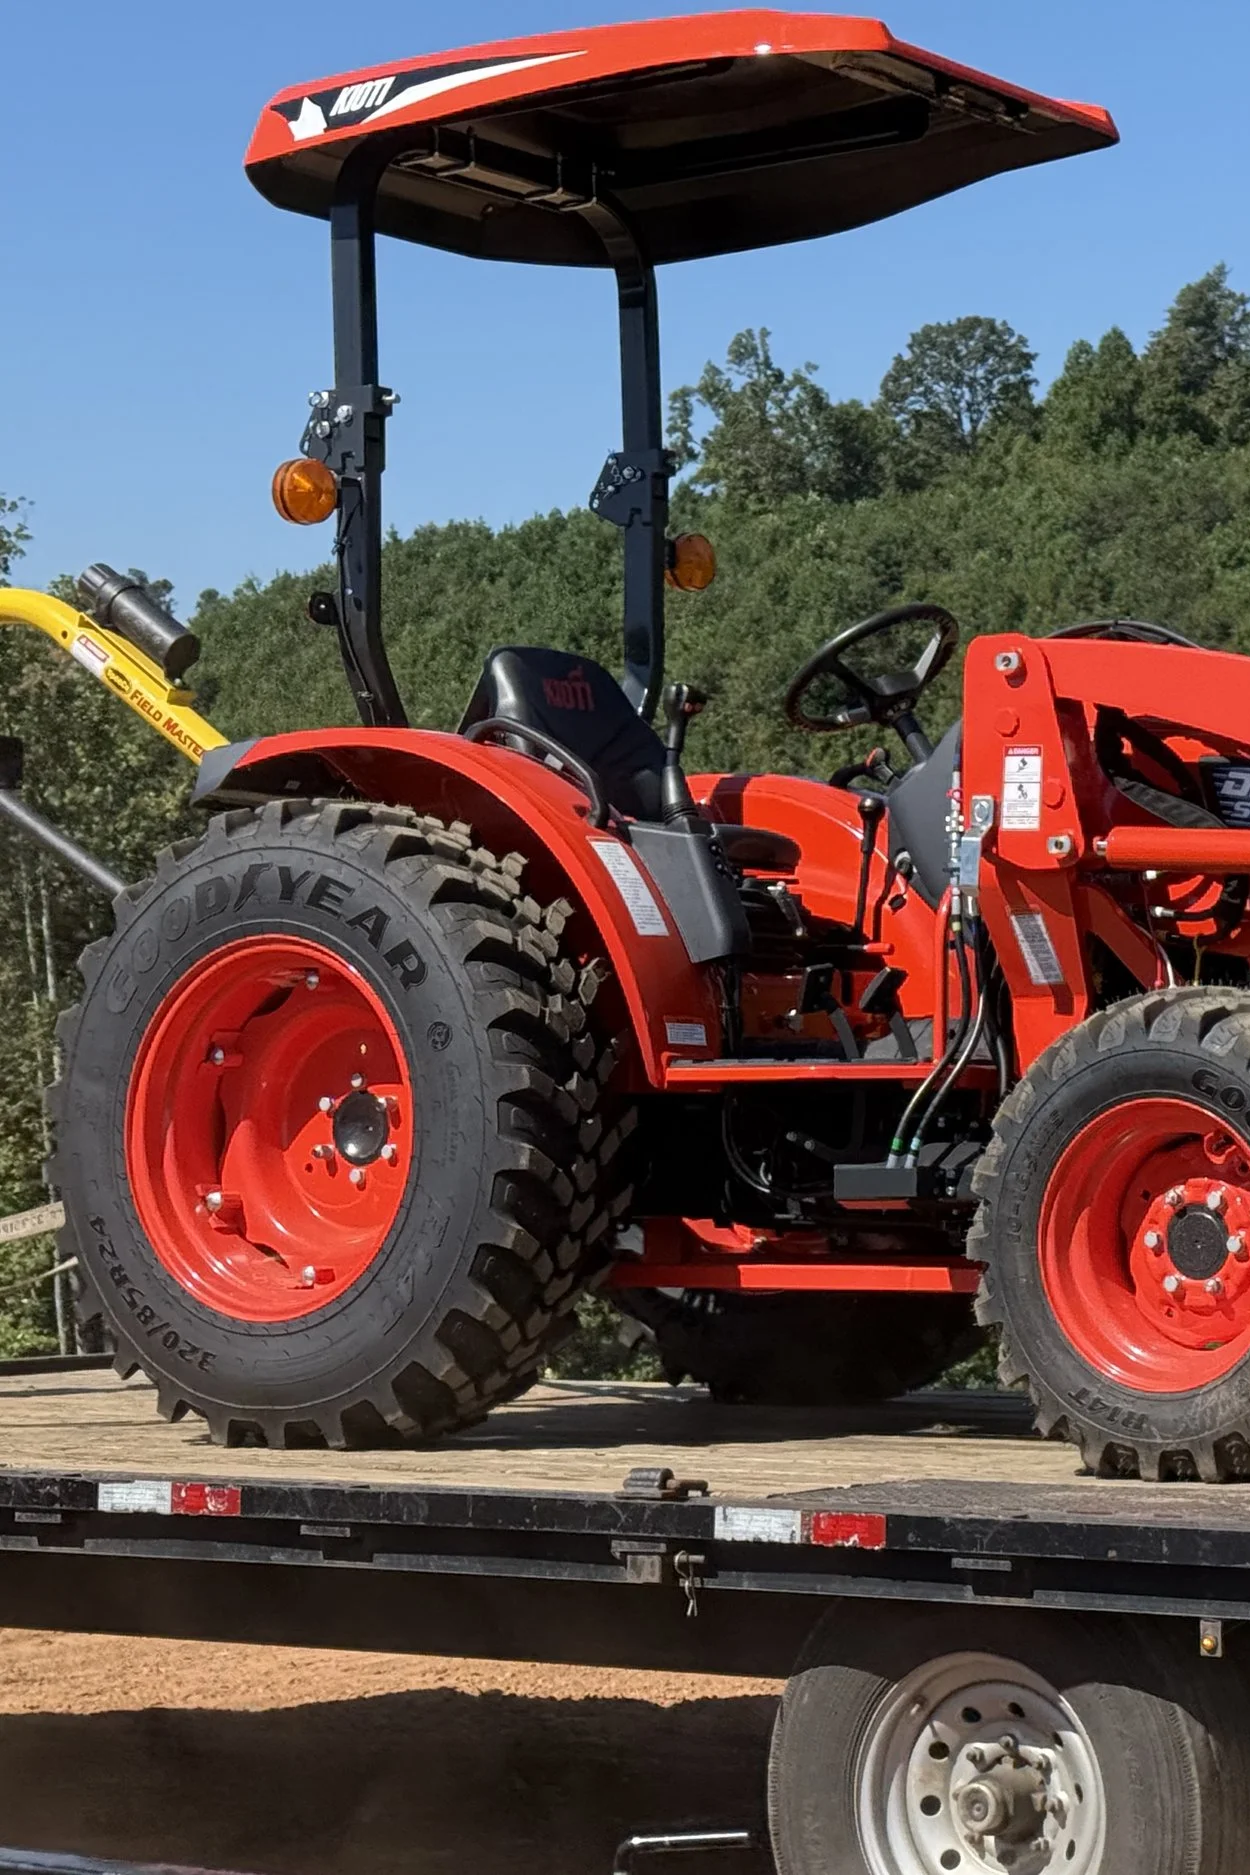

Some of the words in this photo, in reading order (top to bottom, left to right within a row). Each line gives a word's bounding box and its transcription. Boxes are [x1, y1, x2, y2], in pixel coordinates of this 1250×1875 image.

[328, 75, 397, 117] KIOTI
[129, 688, 163, 723] FIELD
[543, 668, 595, 712] KIOTI
[105, 862, 430, 1015] GOODYEAR
[89, 1215, 217, 1374] 320/85R24
[1067, 1386, 1149, 1432] R14T
